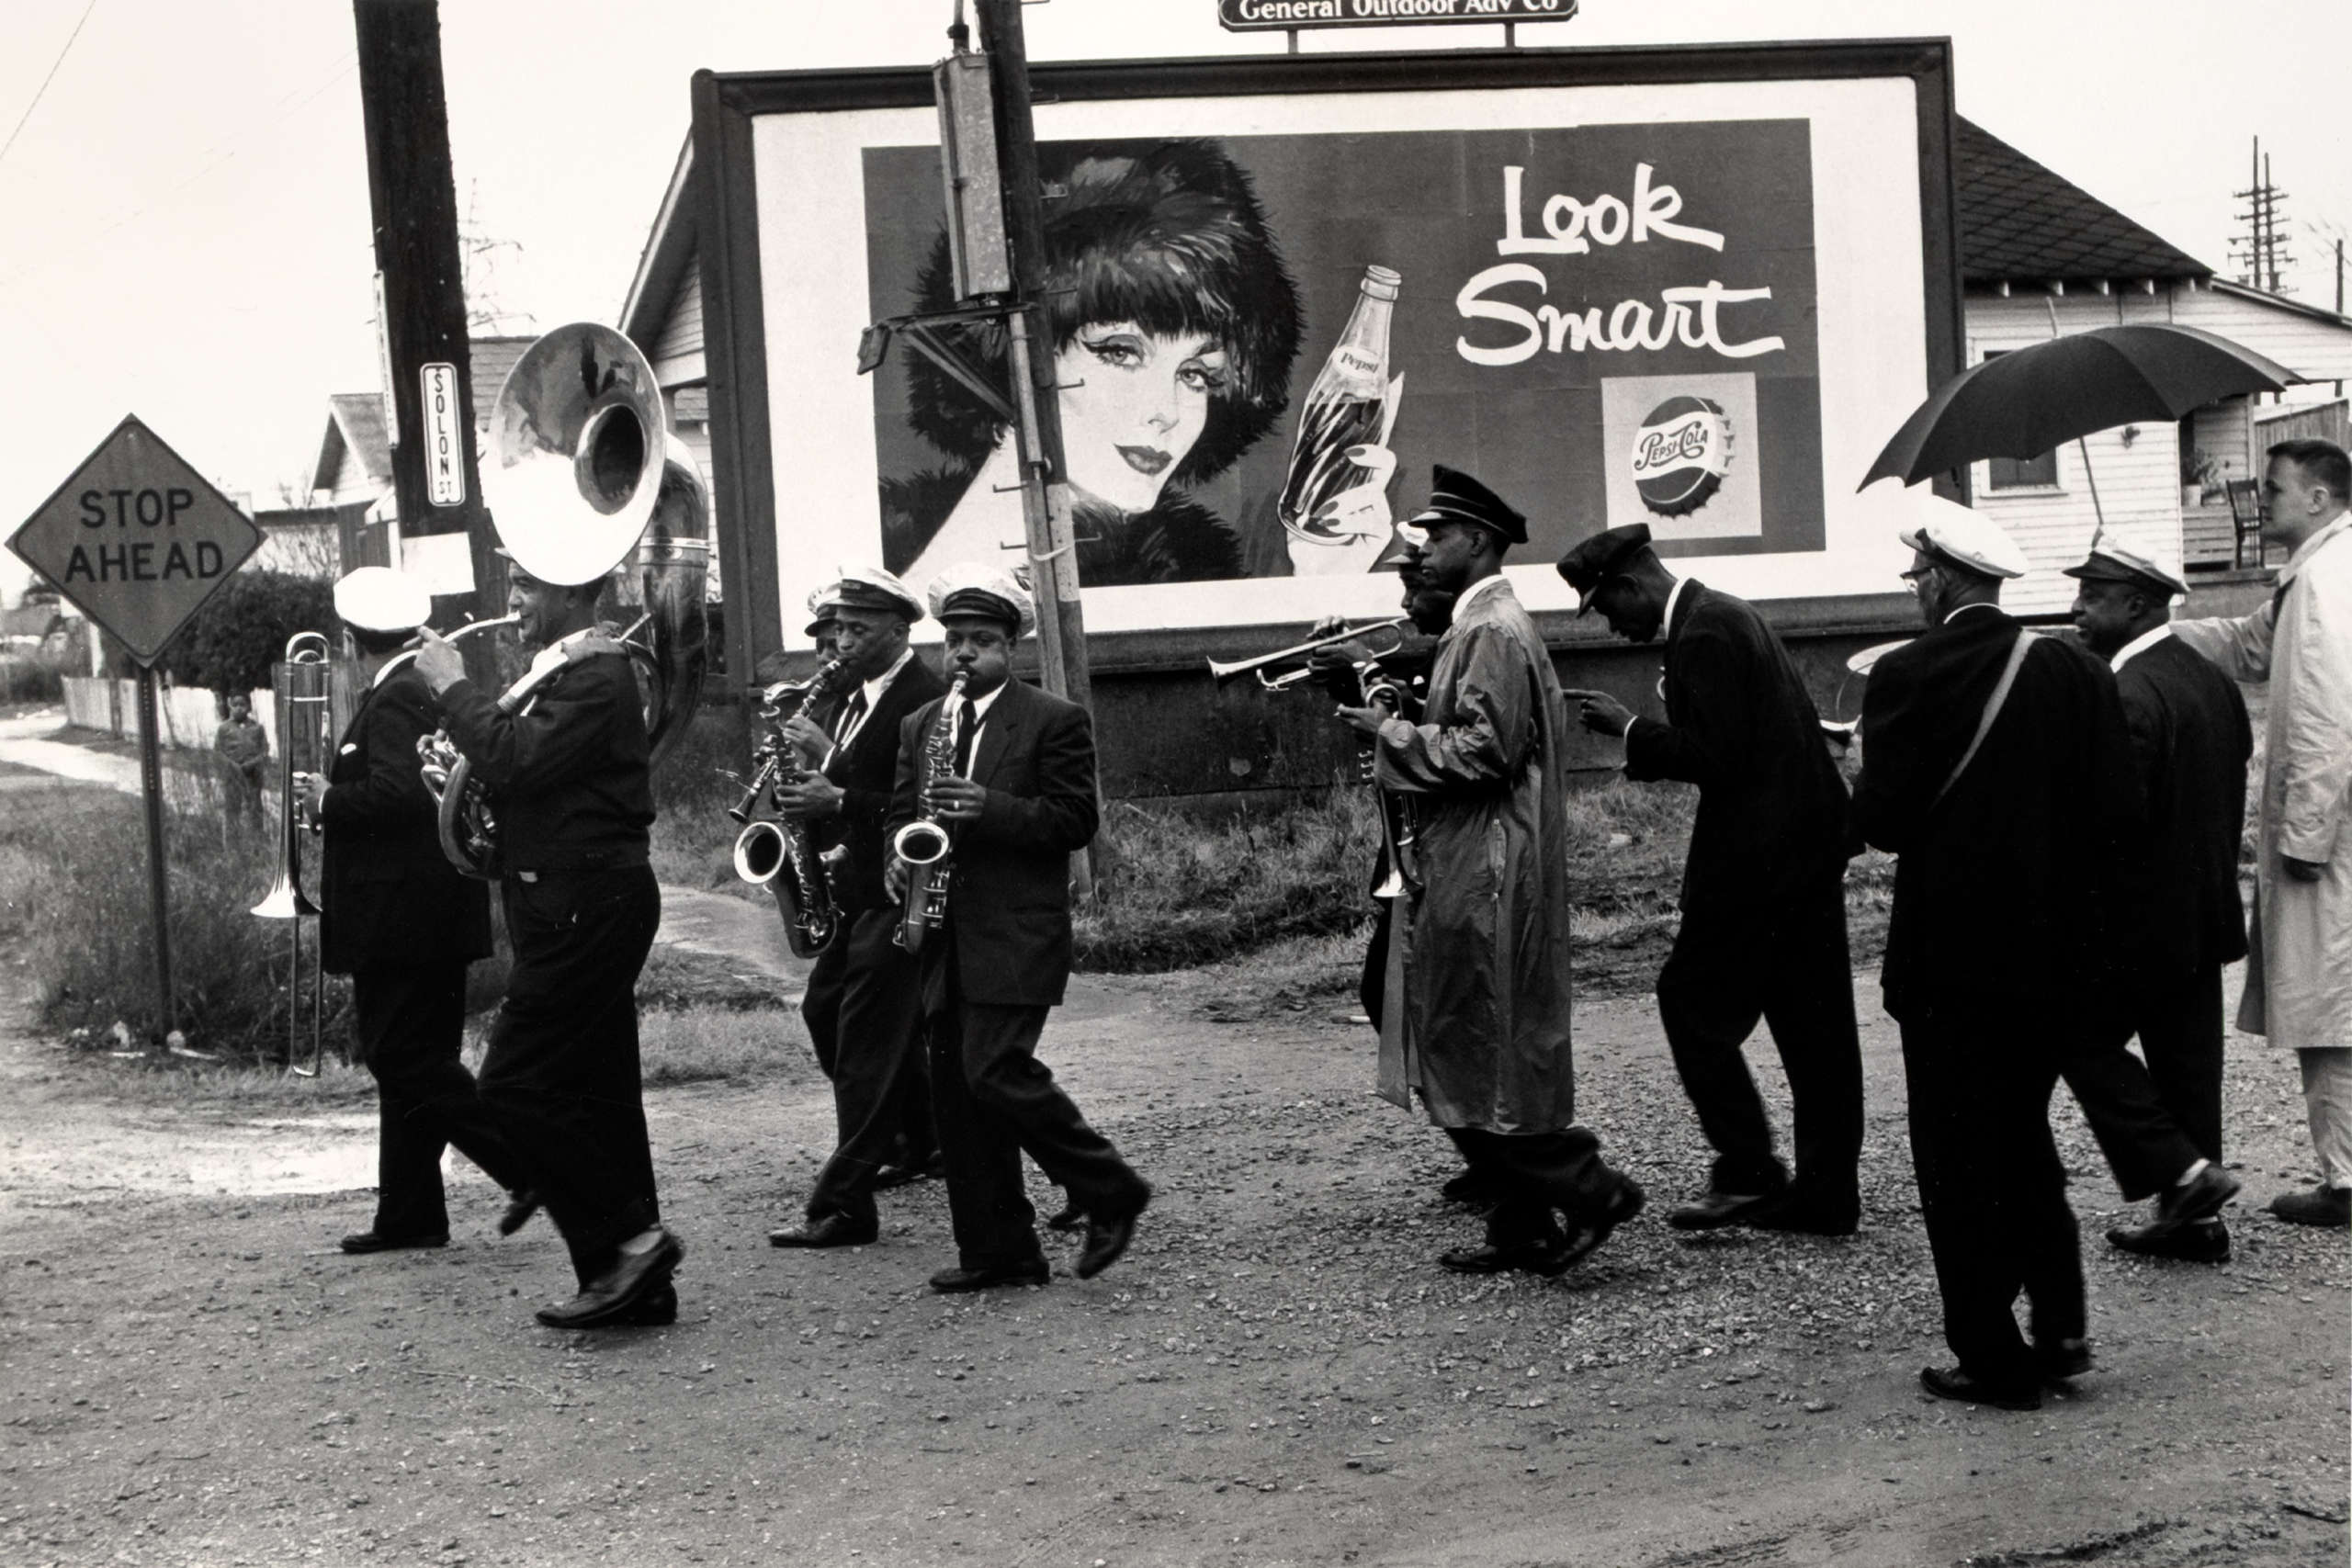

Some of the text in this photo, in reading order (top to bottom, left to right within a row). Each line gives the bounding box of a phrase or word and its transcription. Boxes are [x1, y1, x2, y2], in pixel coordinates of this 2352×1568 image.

[1239, 0, 1342, 19] General
[1352, 0, 1457, 17] Outdoor
[1464, 0, 1514, 13] Adv
[1497, 163, 1725, 255] Look
[1456, 263, 1786, 366] Smart
[434, 372, 449, 477] SOLON
[79, 488, 194, 529] STOP
[438, 480, 452, 495] ST
[64, 540, 224, 584] AHEAD
